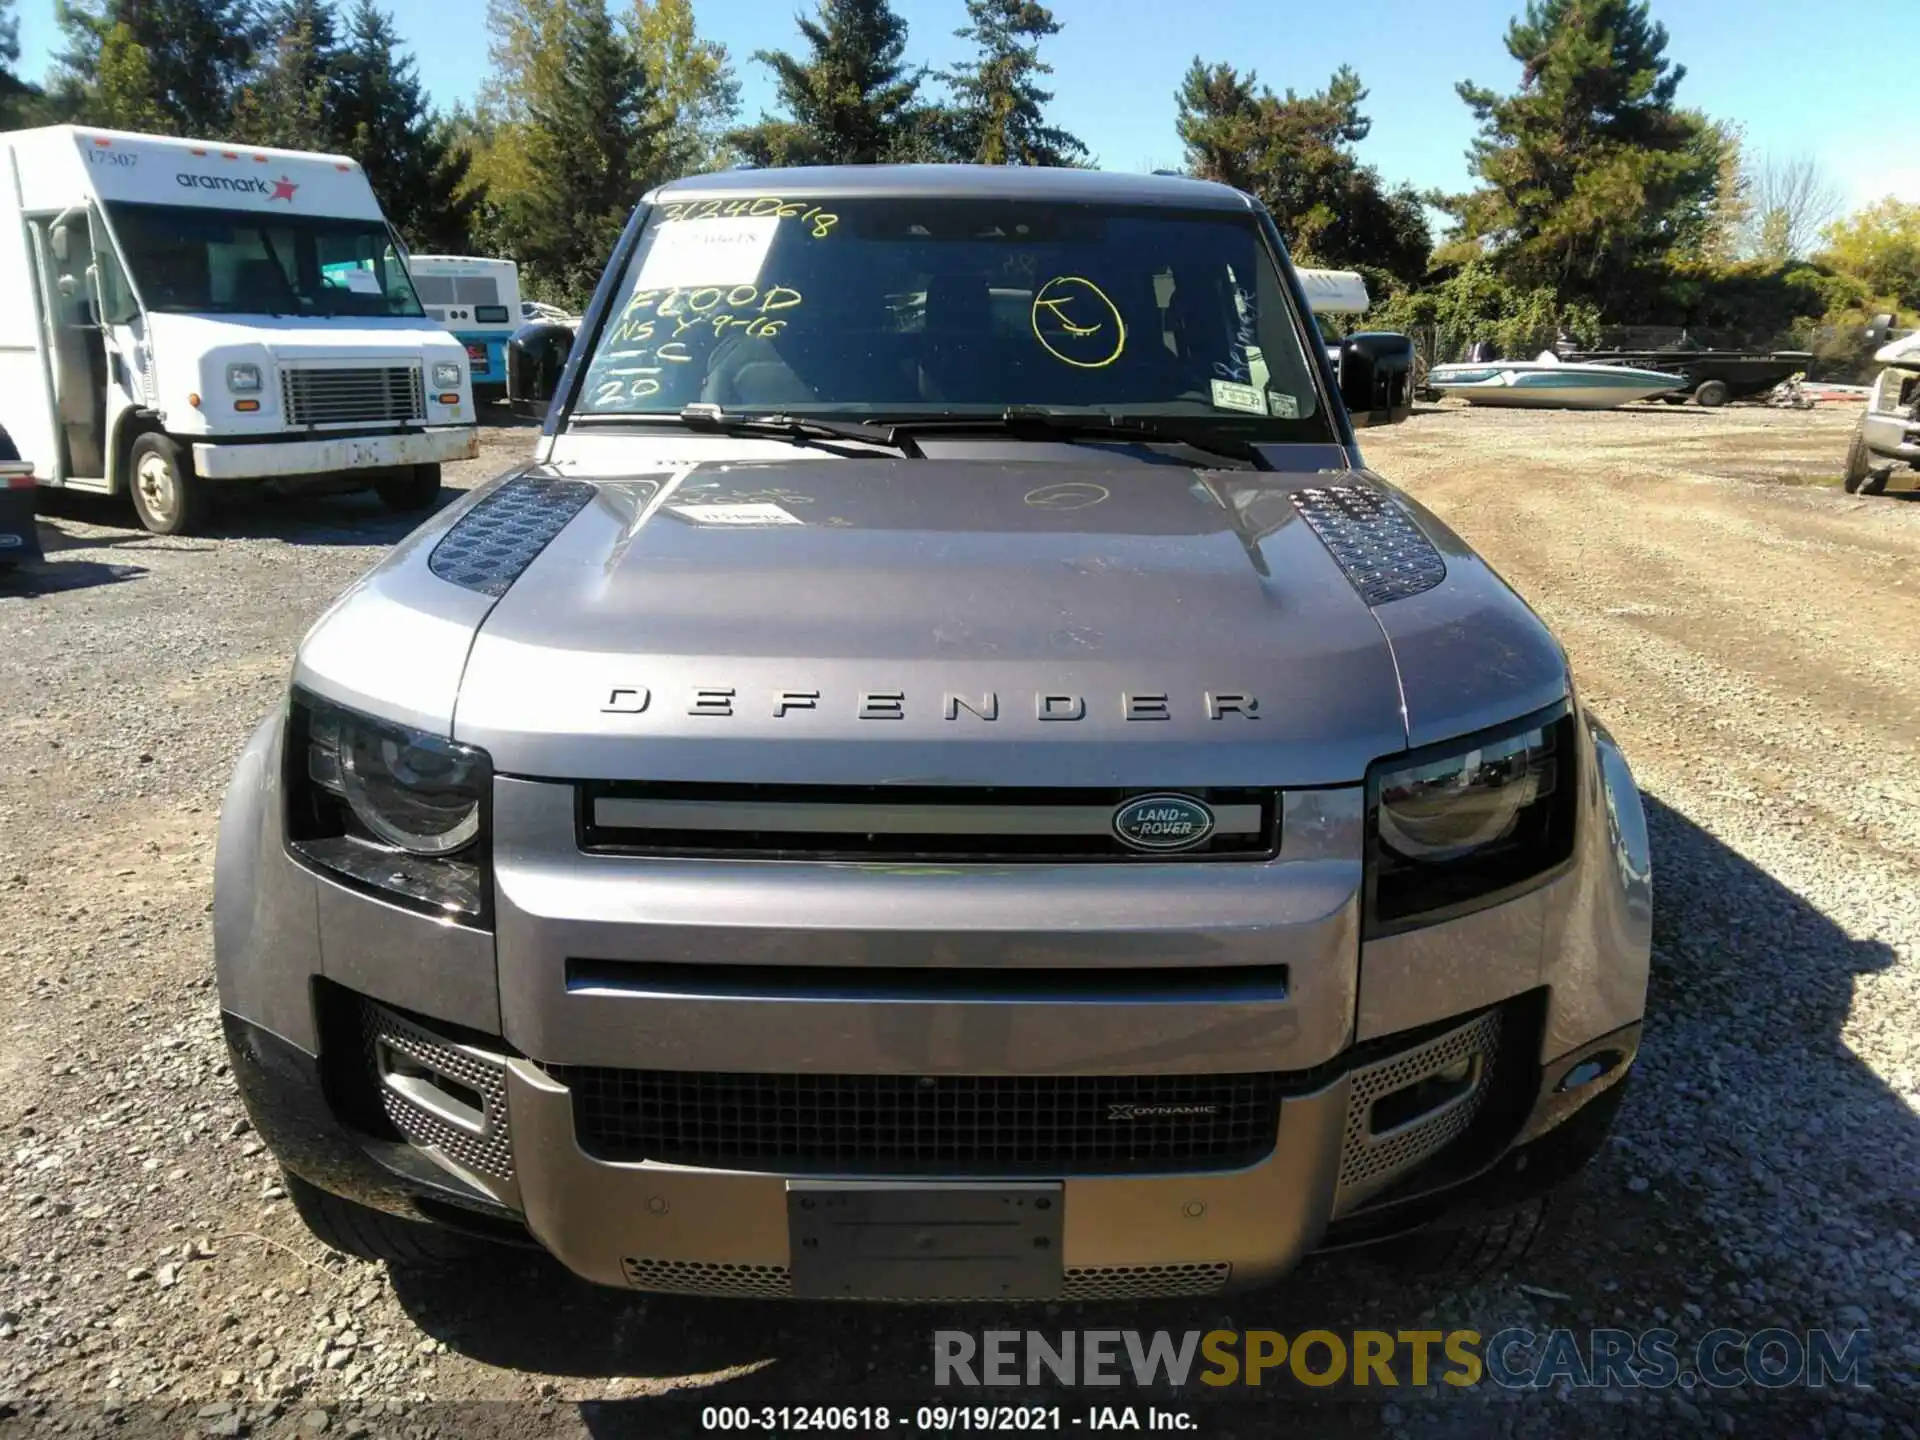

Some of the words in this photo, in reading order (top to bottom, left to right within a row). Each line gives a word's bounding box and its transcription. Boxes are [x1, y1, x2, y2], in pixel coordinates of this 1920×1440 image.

[86, 149, 139, 168] 17507
[176, 172, 271, 195] aramark
[625, 285, 802, 319] FLOOD
[599, 684, 1262, 721] DEFENDER
